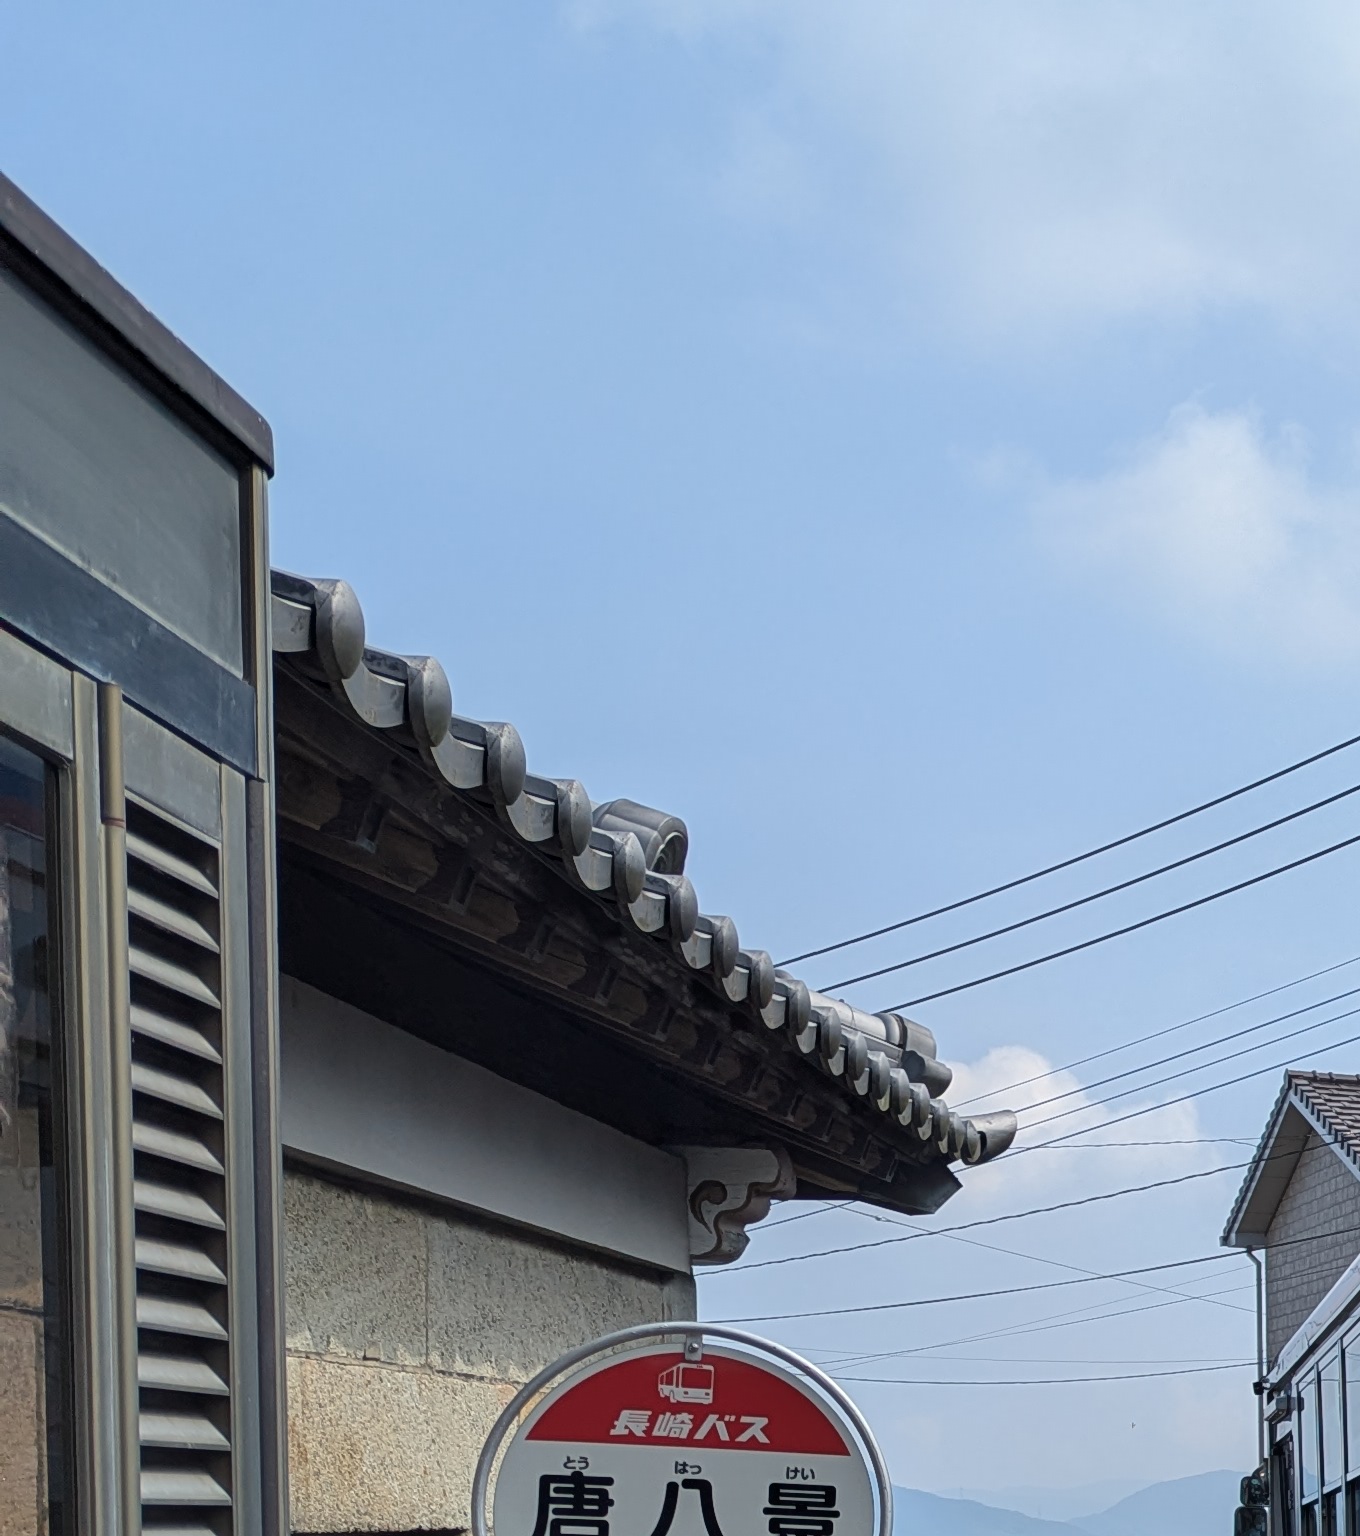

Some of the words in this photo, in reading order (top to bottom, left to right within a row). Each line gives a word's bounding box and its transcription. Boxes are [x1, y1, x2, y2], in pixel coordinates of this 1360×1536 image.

[609, 1409, 771, 1444] 長崎バス
[563, 1455, 590, 1471] とう
[785, 1466, 816, 1481] けい
